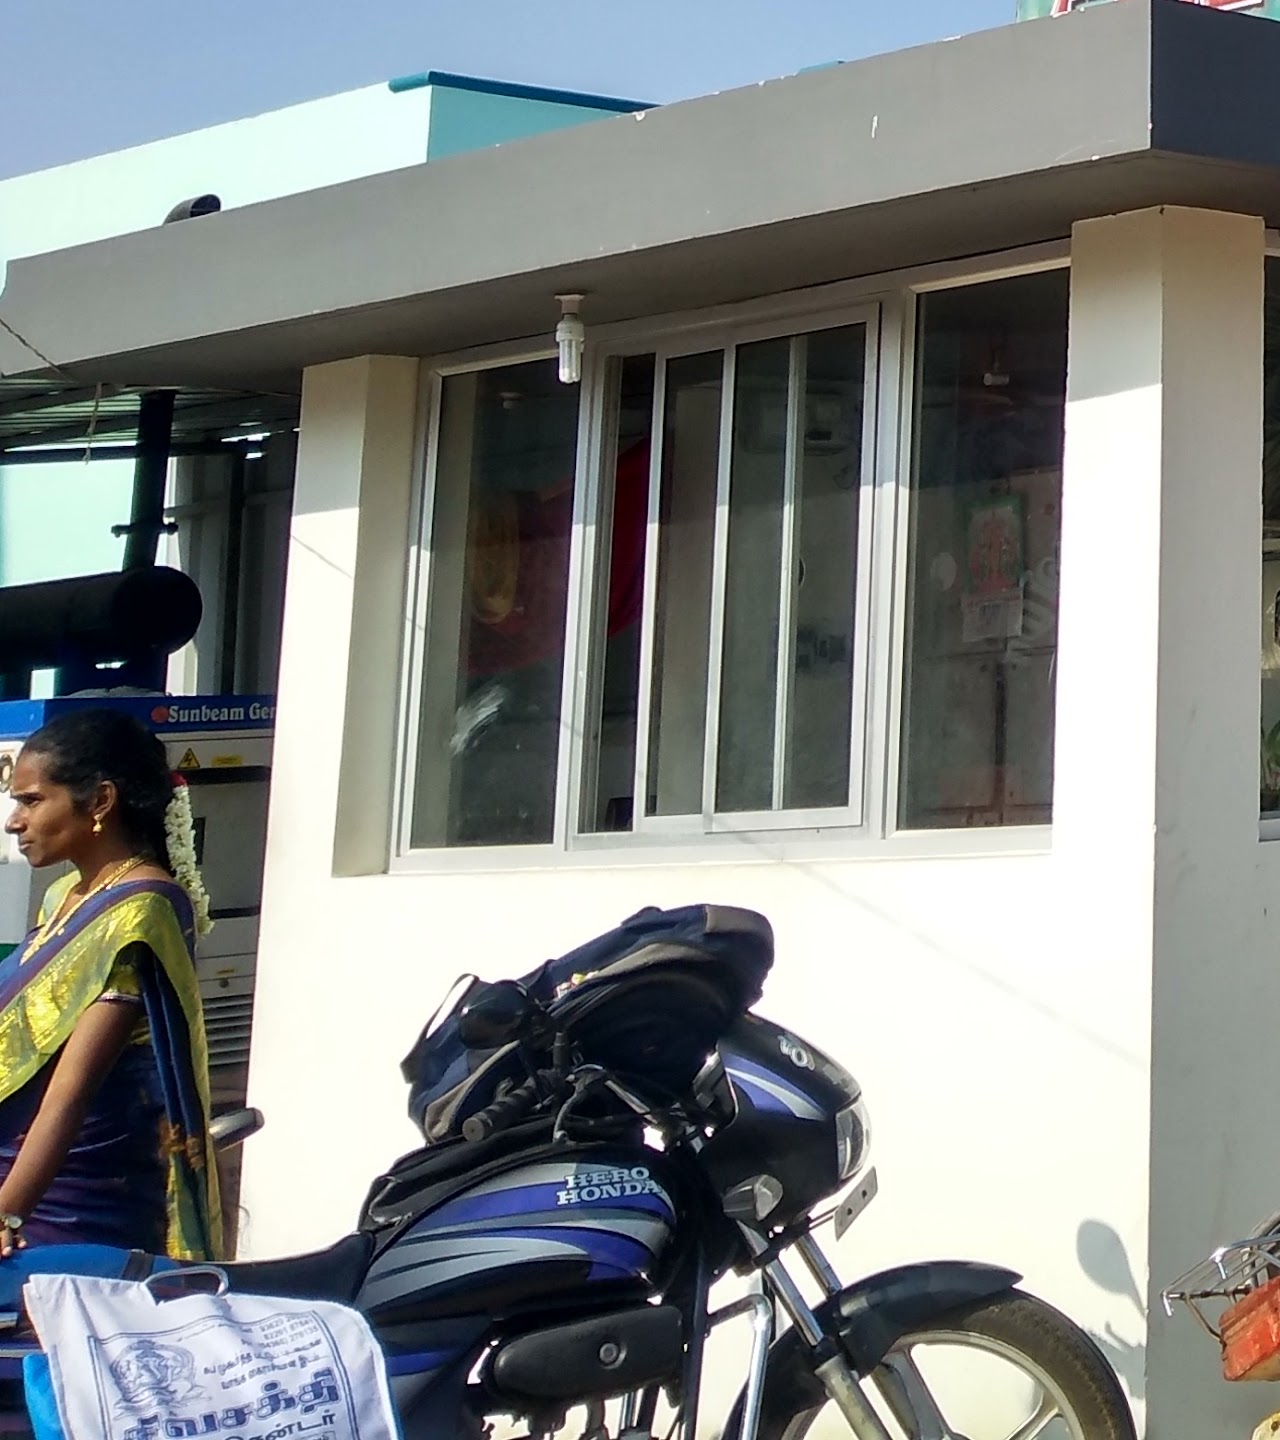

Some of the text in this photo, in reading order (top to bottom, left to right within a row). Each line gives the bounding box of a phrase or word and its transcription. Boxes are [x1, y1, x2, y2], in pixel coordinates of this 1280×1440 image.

[168, 704, 245, 723] Sunbeam
[565, 1166, 650, 1190] HERO
[557, 1180, 664, 1206] HONDA
